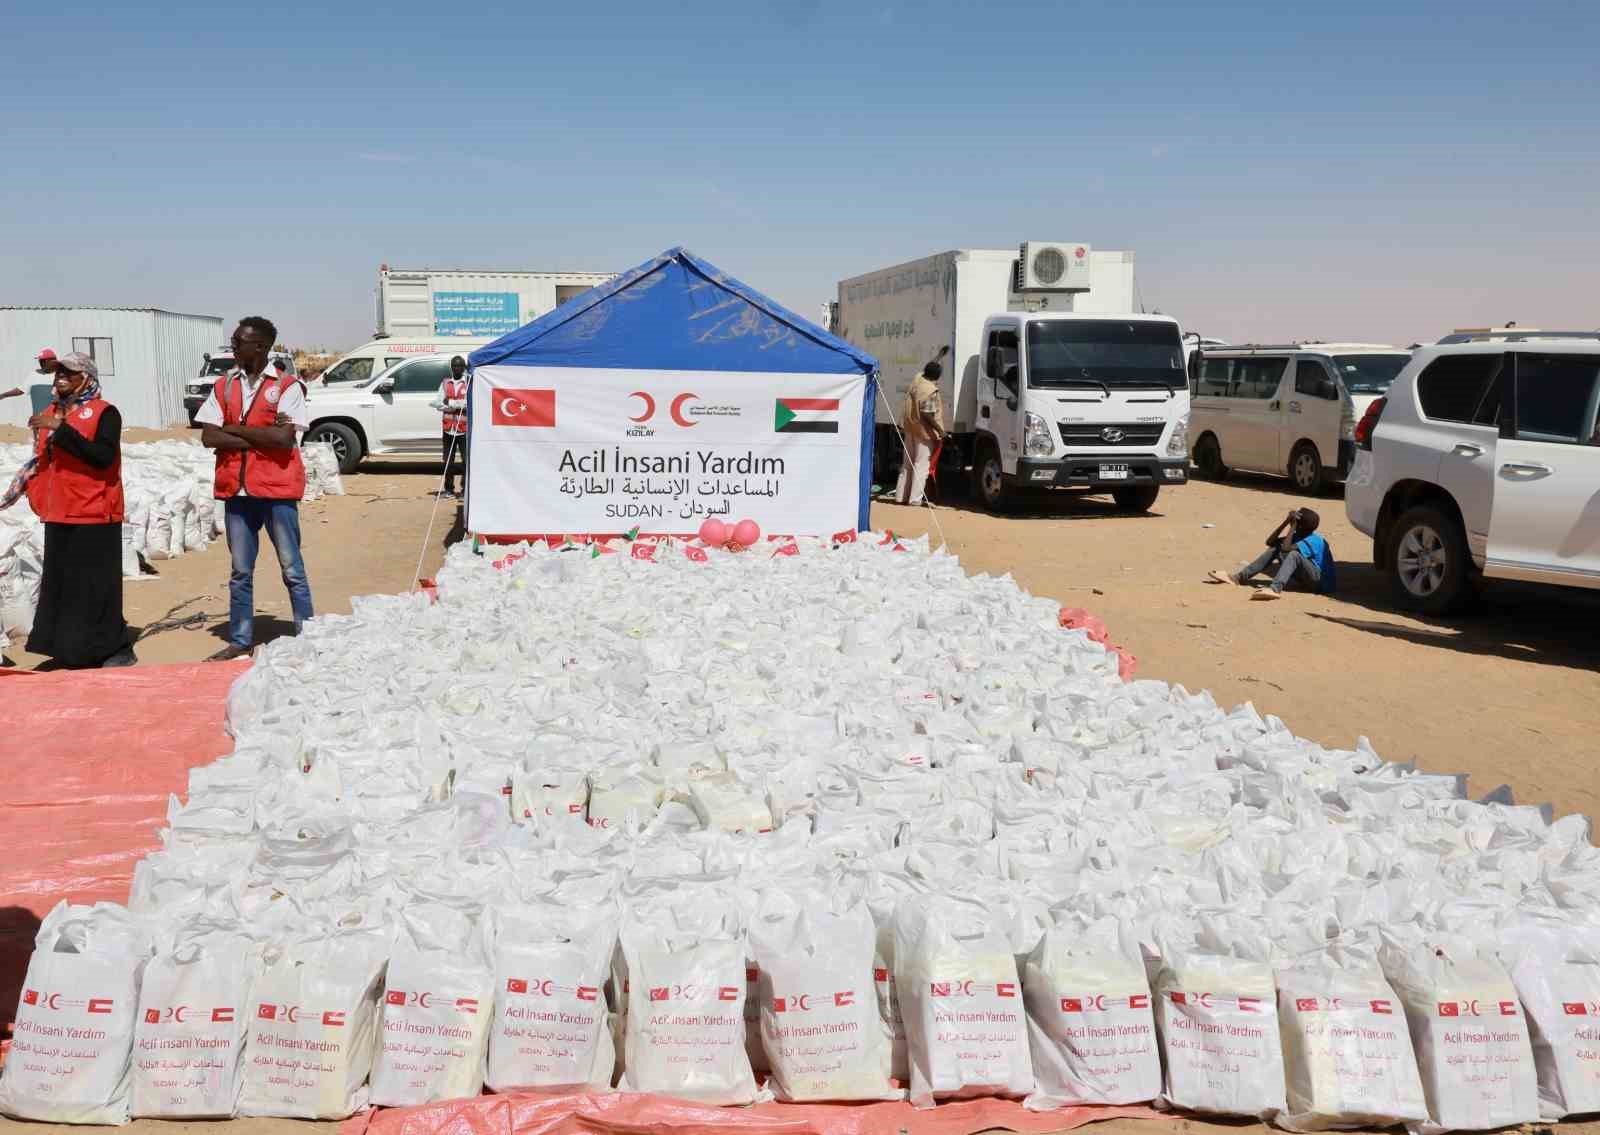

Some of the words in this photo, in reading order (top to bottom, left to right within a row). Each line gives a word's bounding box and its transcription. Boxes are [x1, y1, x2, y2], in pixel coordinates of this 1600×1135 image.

[558, 449, 605, 473] Acil
[615, 446, 690, 474] İnsani
[697, 450, 785, 475] Yardım
[559, 476, 614, 498] الطارئة
[622, 477, 689, 500] الإنسانية
[697, 479, 779, 498] المساعدات
[605, 504, 663, 518] SUDAN
[679, 500, 730, 519] السودان
[505, 1007, 524, 1018] Acil
[560, 1011, 594, 1025] Yardım
[1172, 1018, 1191, 1030] Acil
[1225, 1022, 1262, 1039] Yardım
